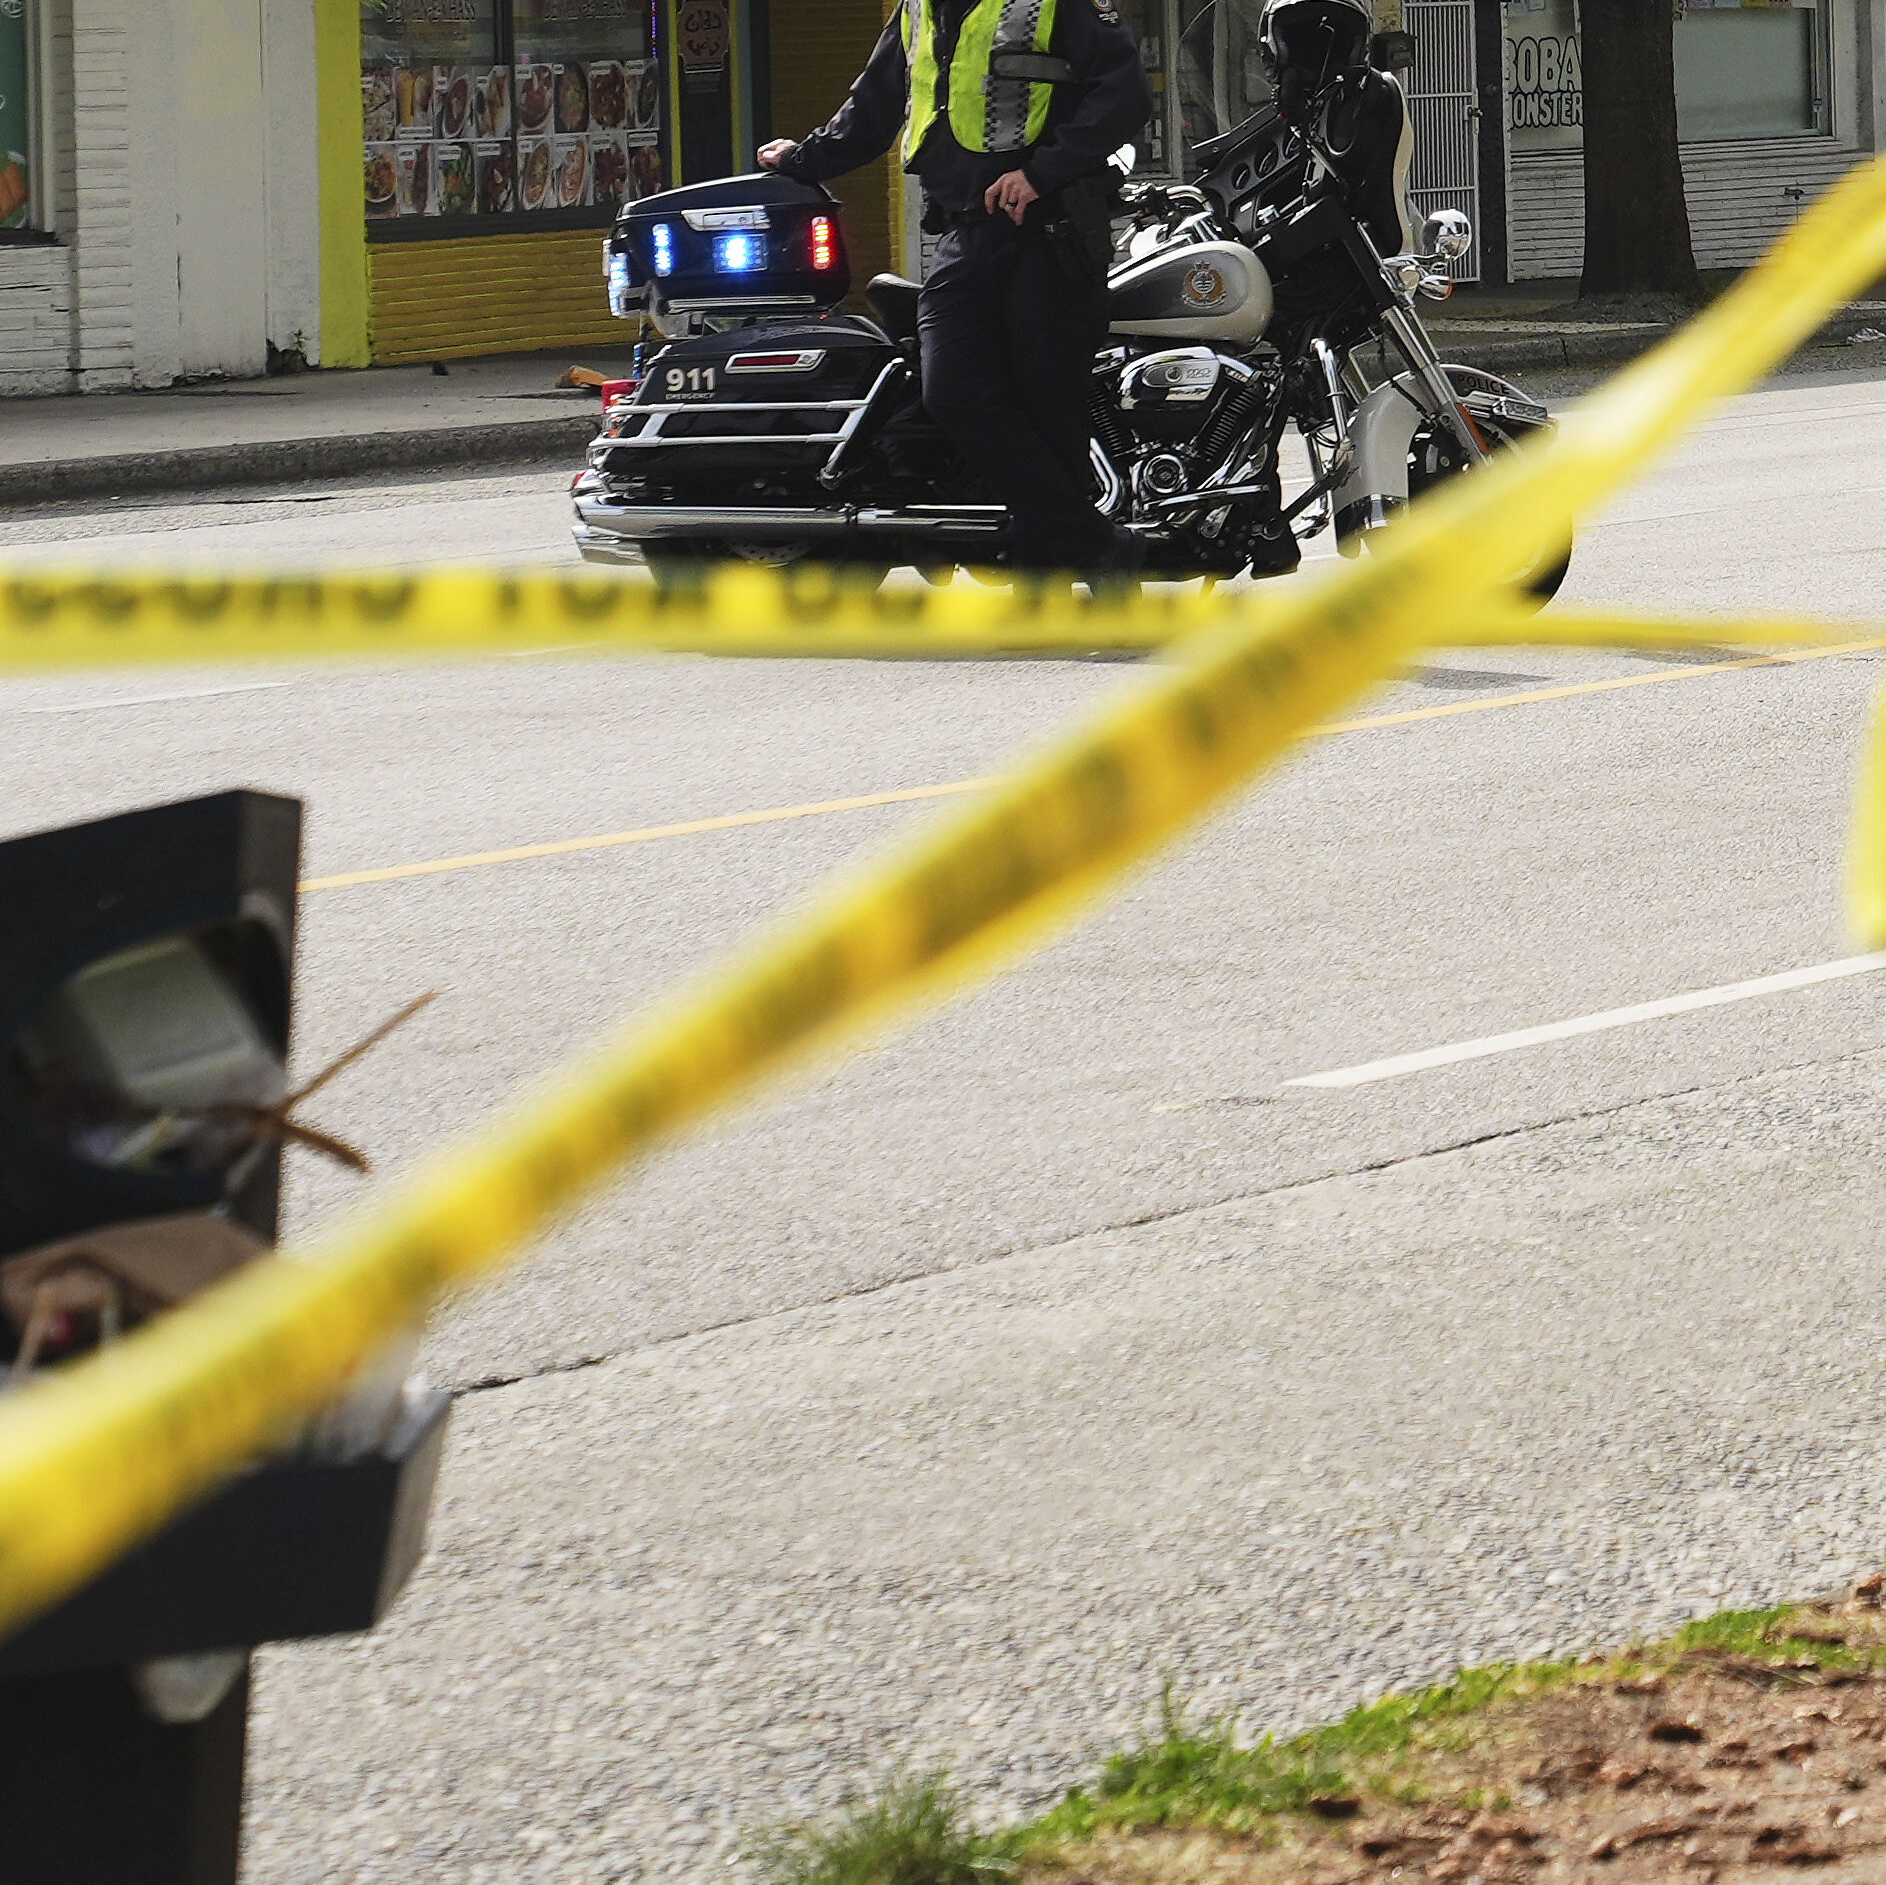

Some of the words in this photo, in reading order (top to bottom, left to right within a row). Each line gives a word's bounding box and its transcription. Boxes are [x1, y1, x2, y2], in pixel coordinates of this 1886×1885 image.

[1508, 92, 1584, 129] ONSTER
[665, 367, 717, 392] 911
[1457, 372, 1511, 395] POLICE
